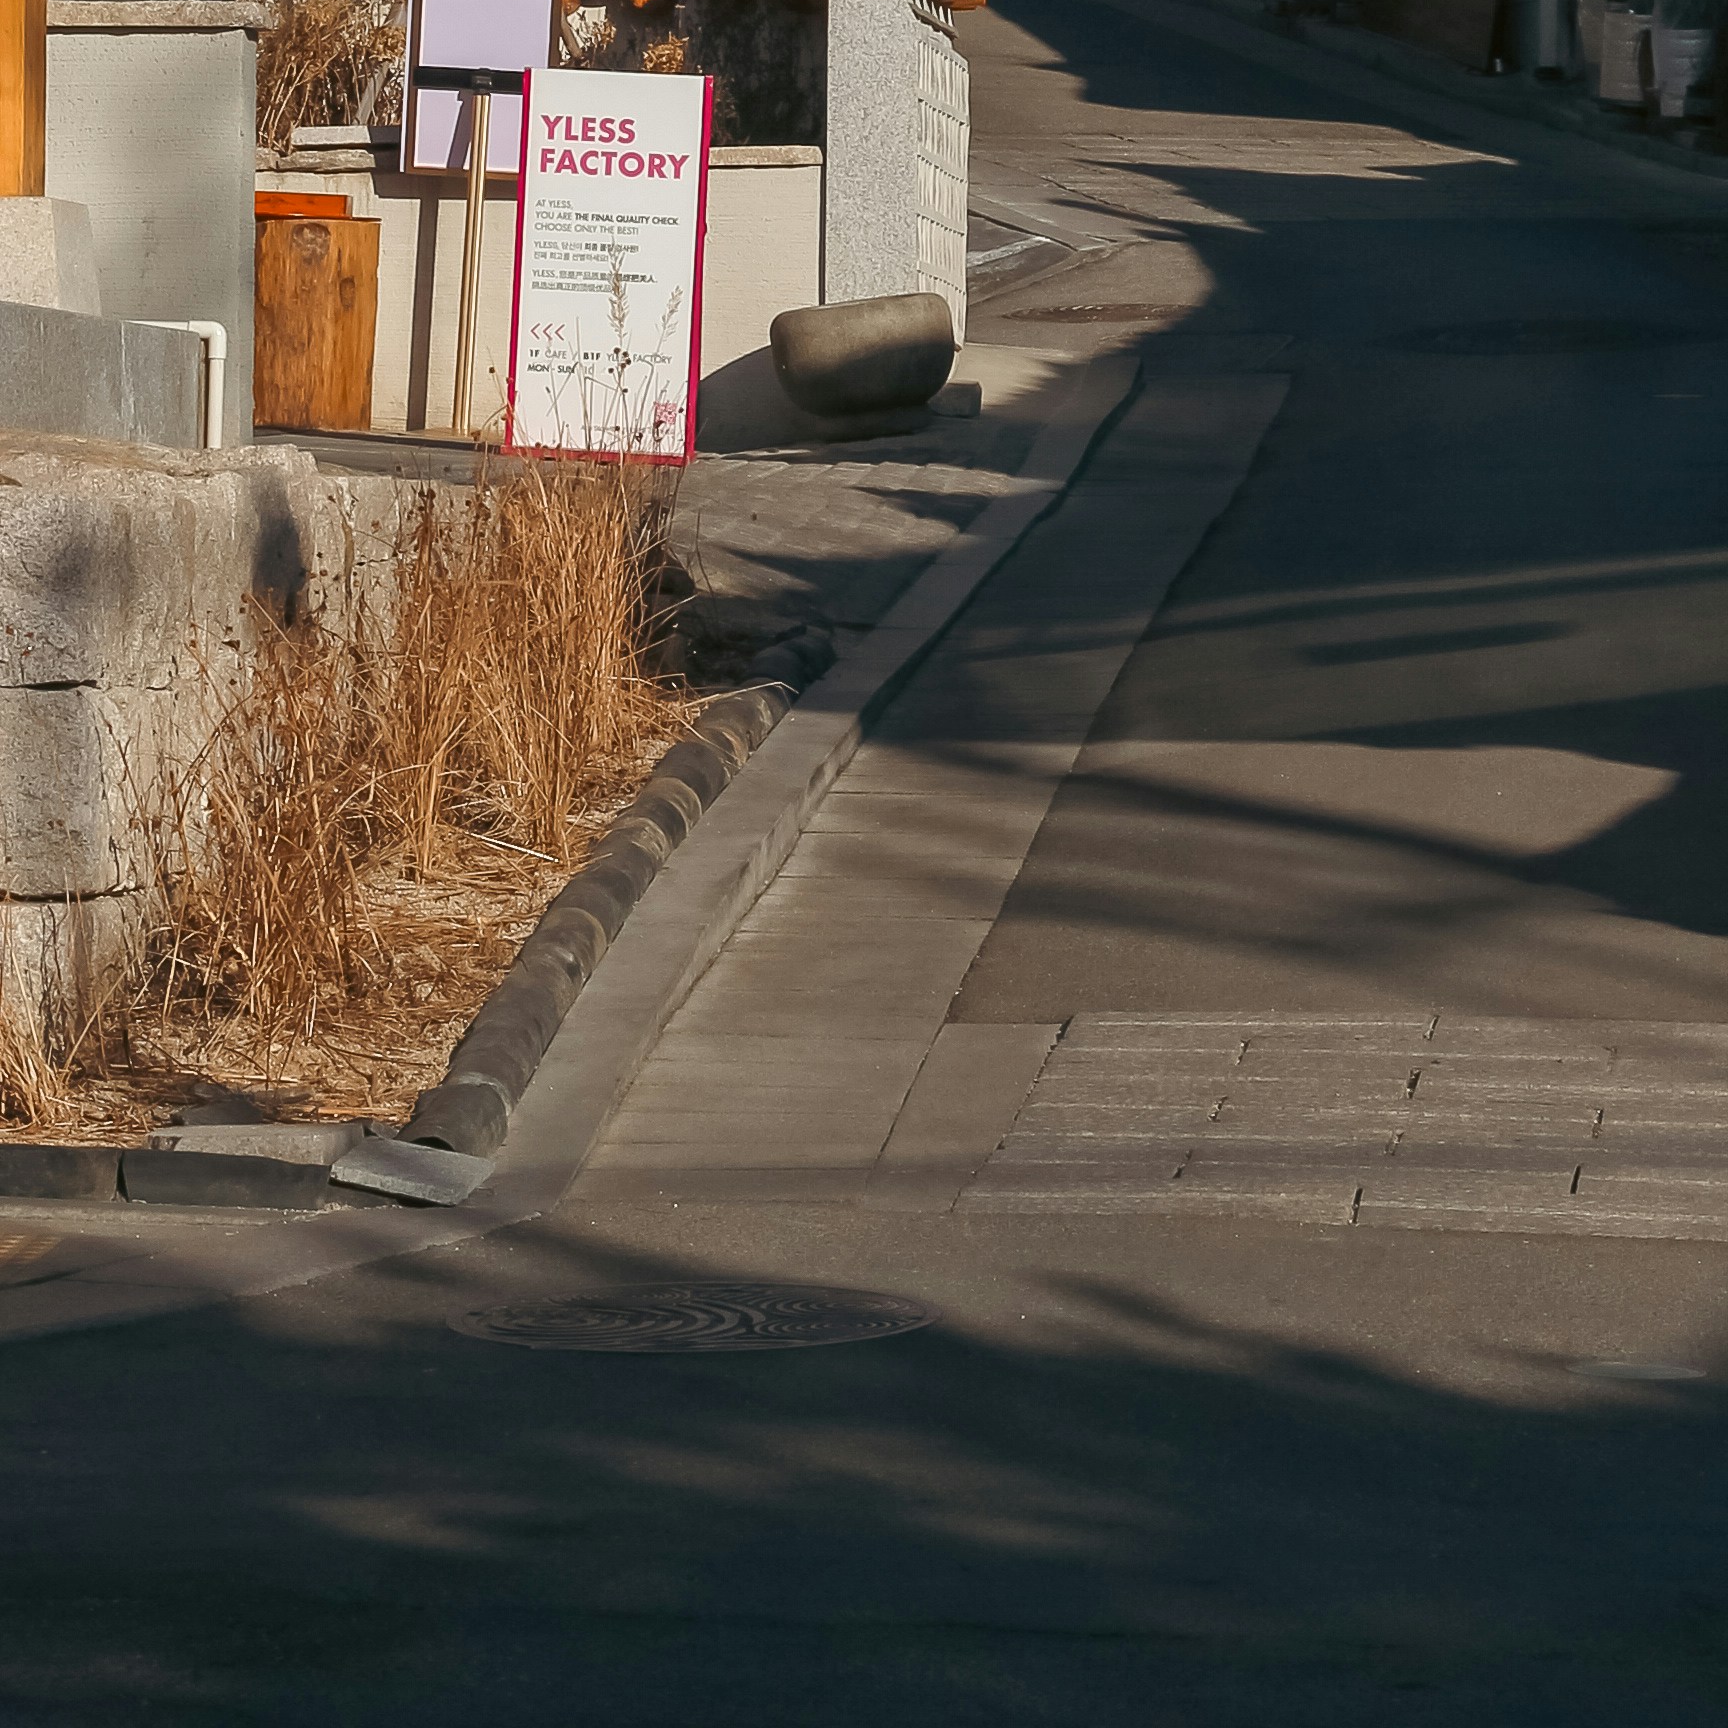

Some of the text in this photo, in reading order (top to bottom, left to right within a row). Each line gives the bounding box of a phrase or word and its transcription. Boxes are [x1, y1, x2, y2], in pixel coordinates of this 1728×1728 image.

[540, 114, 636, 144] YLESS
[539, 147, 690, 180] FACTORY
[535, 199, 546, 208] AT
[535, 210, 555, 220] YOU
[556, 212, 573, 221] ARE
[574, 212, 590, 222] THE
[590, 213, 614, 224] FINAL
[615, 214, 651, 226] QUALITY
[534, 222, 572, 233] CHOOSE
[574, 224, 599, 235] ONLY
[599, 225, 615, 235] THE
[529, 348, 540, 358] 1F
[544, 348, 567, 360] CAFE
[583, 352, 601, 361] B1F
[527, 363, 550, 373] MON
